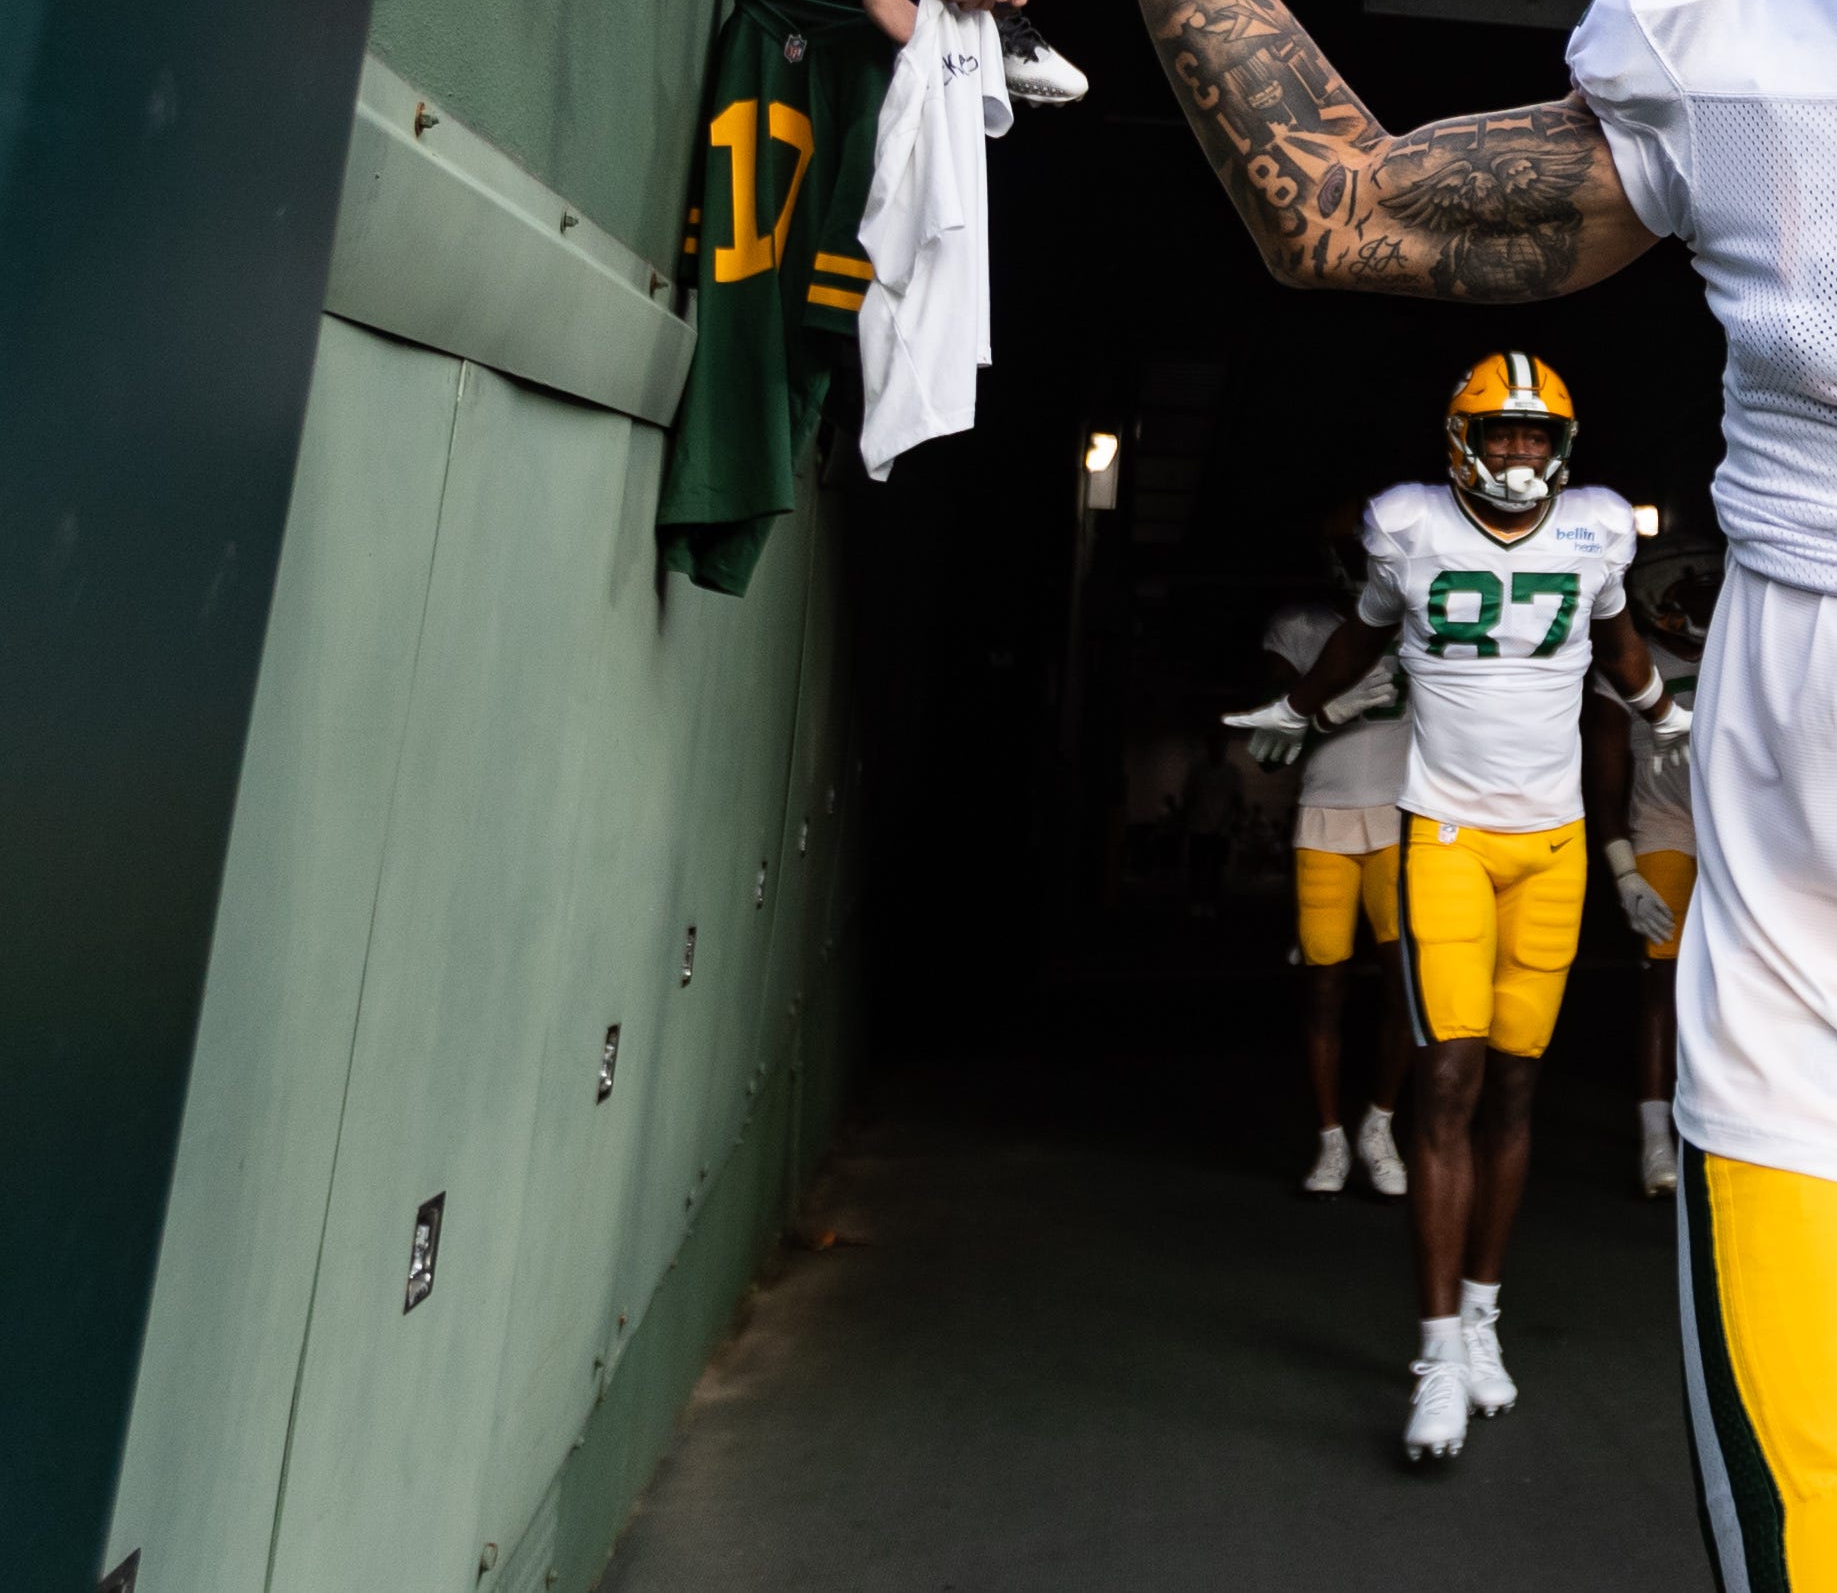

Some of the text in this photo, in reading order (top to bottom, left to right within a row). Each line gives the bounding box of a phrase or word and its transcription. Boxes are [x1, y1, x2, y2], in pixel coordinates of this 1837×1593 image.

[711, 99, 815, 283] 17
[1556, 527, 1595, 541] bellin
[1427, 571, 1580, 659] 87
